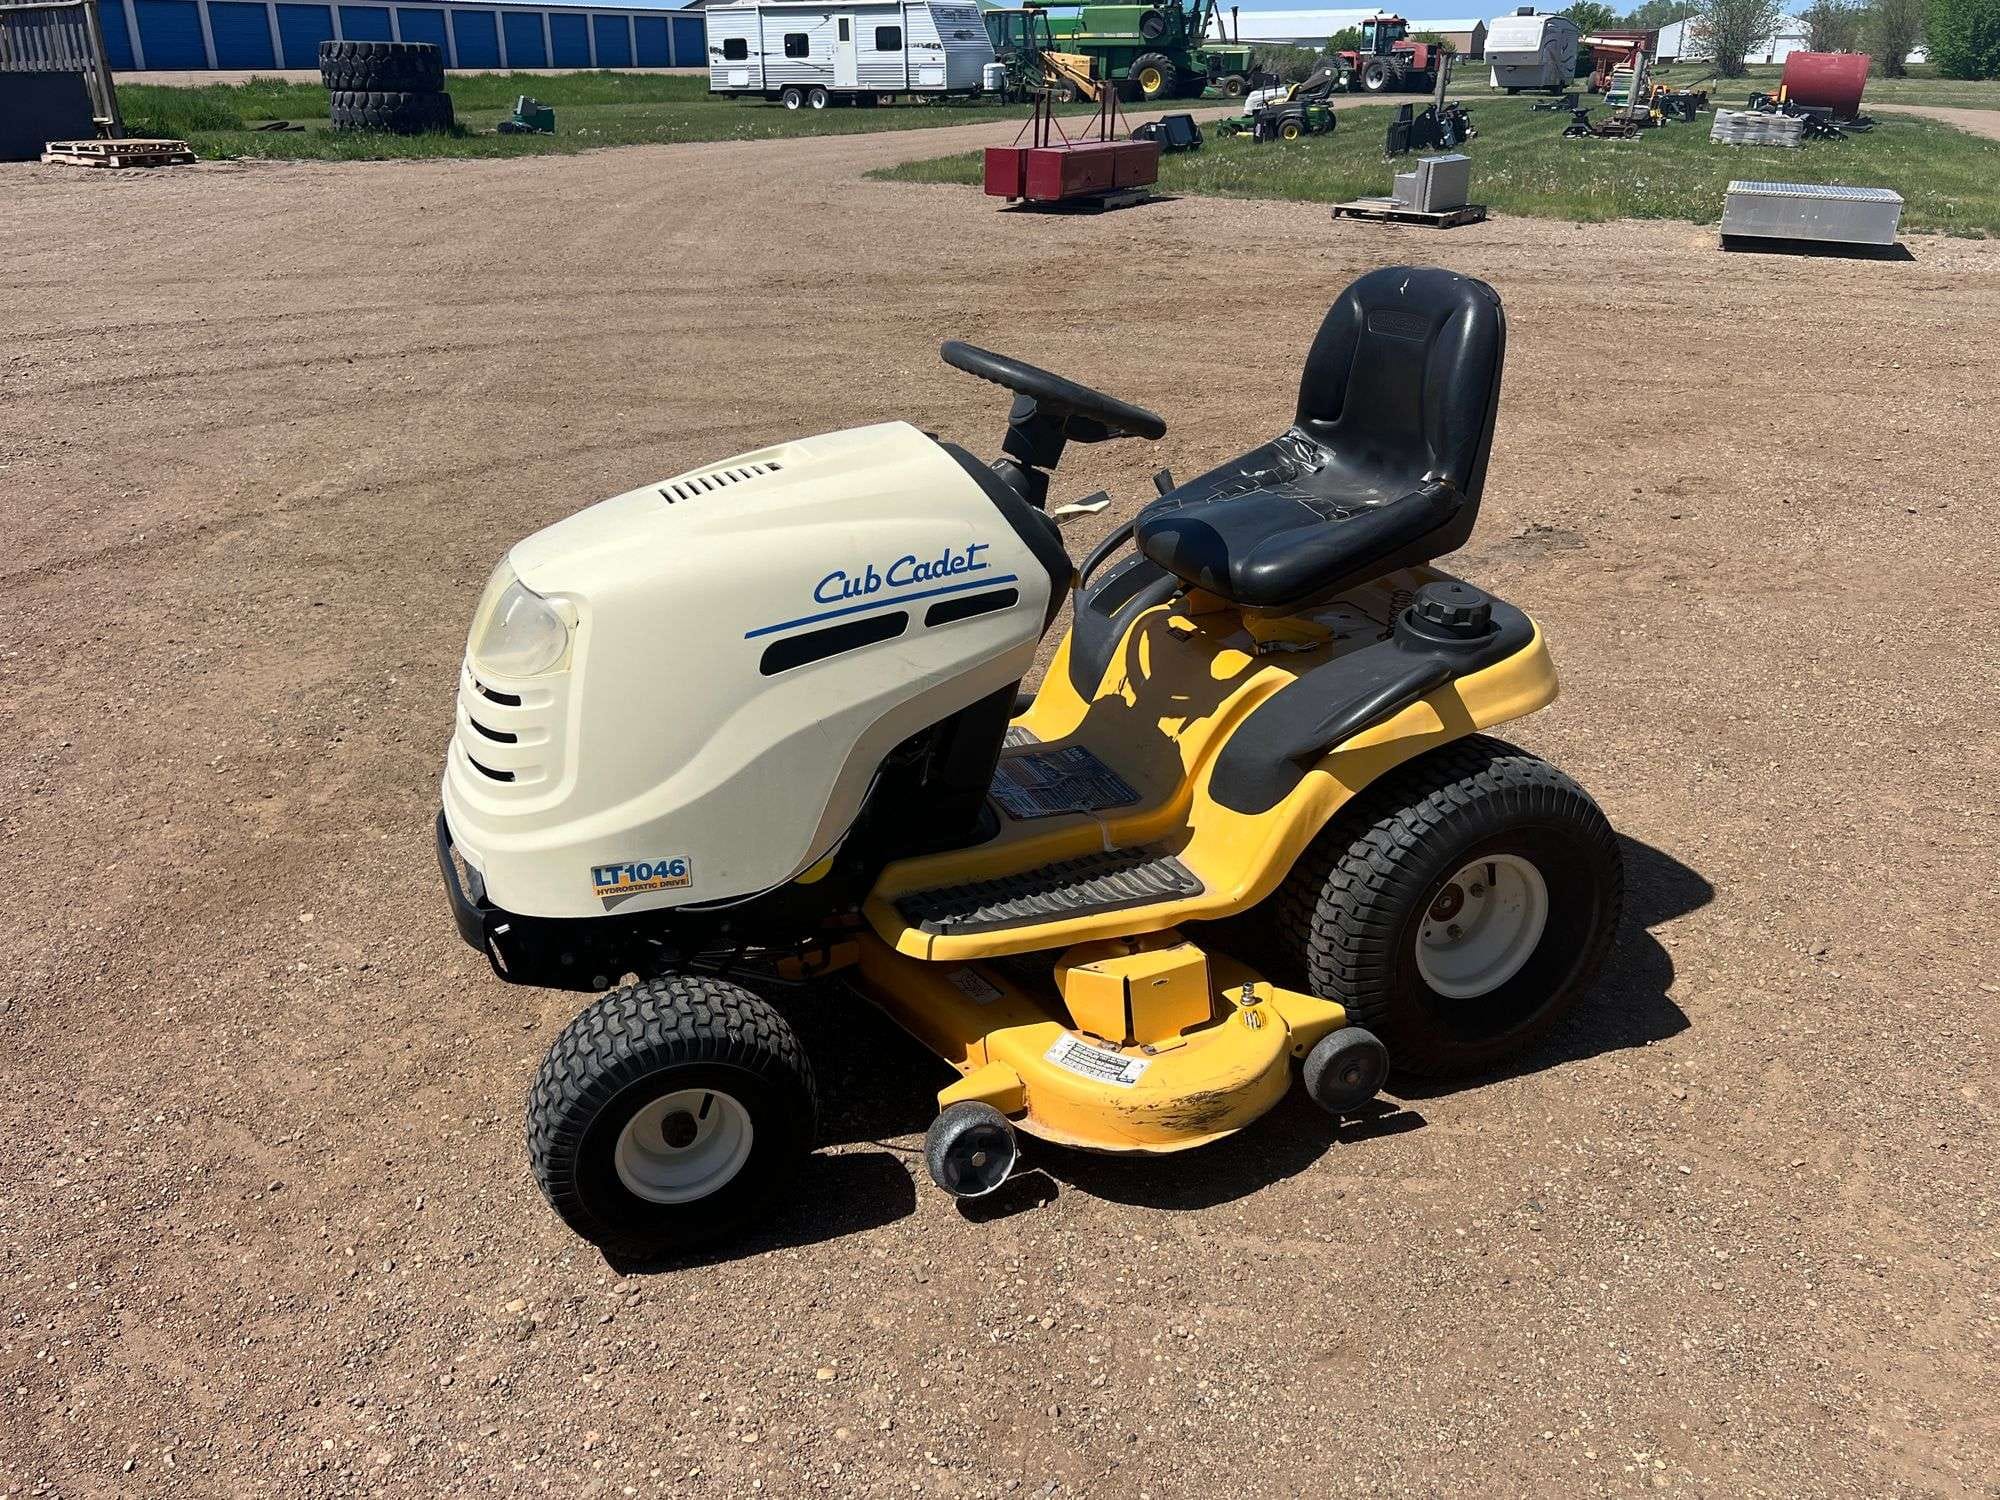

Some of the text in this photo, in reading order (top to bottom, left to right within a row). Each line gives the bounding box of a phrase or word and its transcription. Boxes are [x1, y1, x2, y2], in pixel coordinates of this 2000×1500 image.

[813, 543, 989, 604] Cub Cadet
[596, 879, 686, 896] HYDROSTATIC DRIVE
